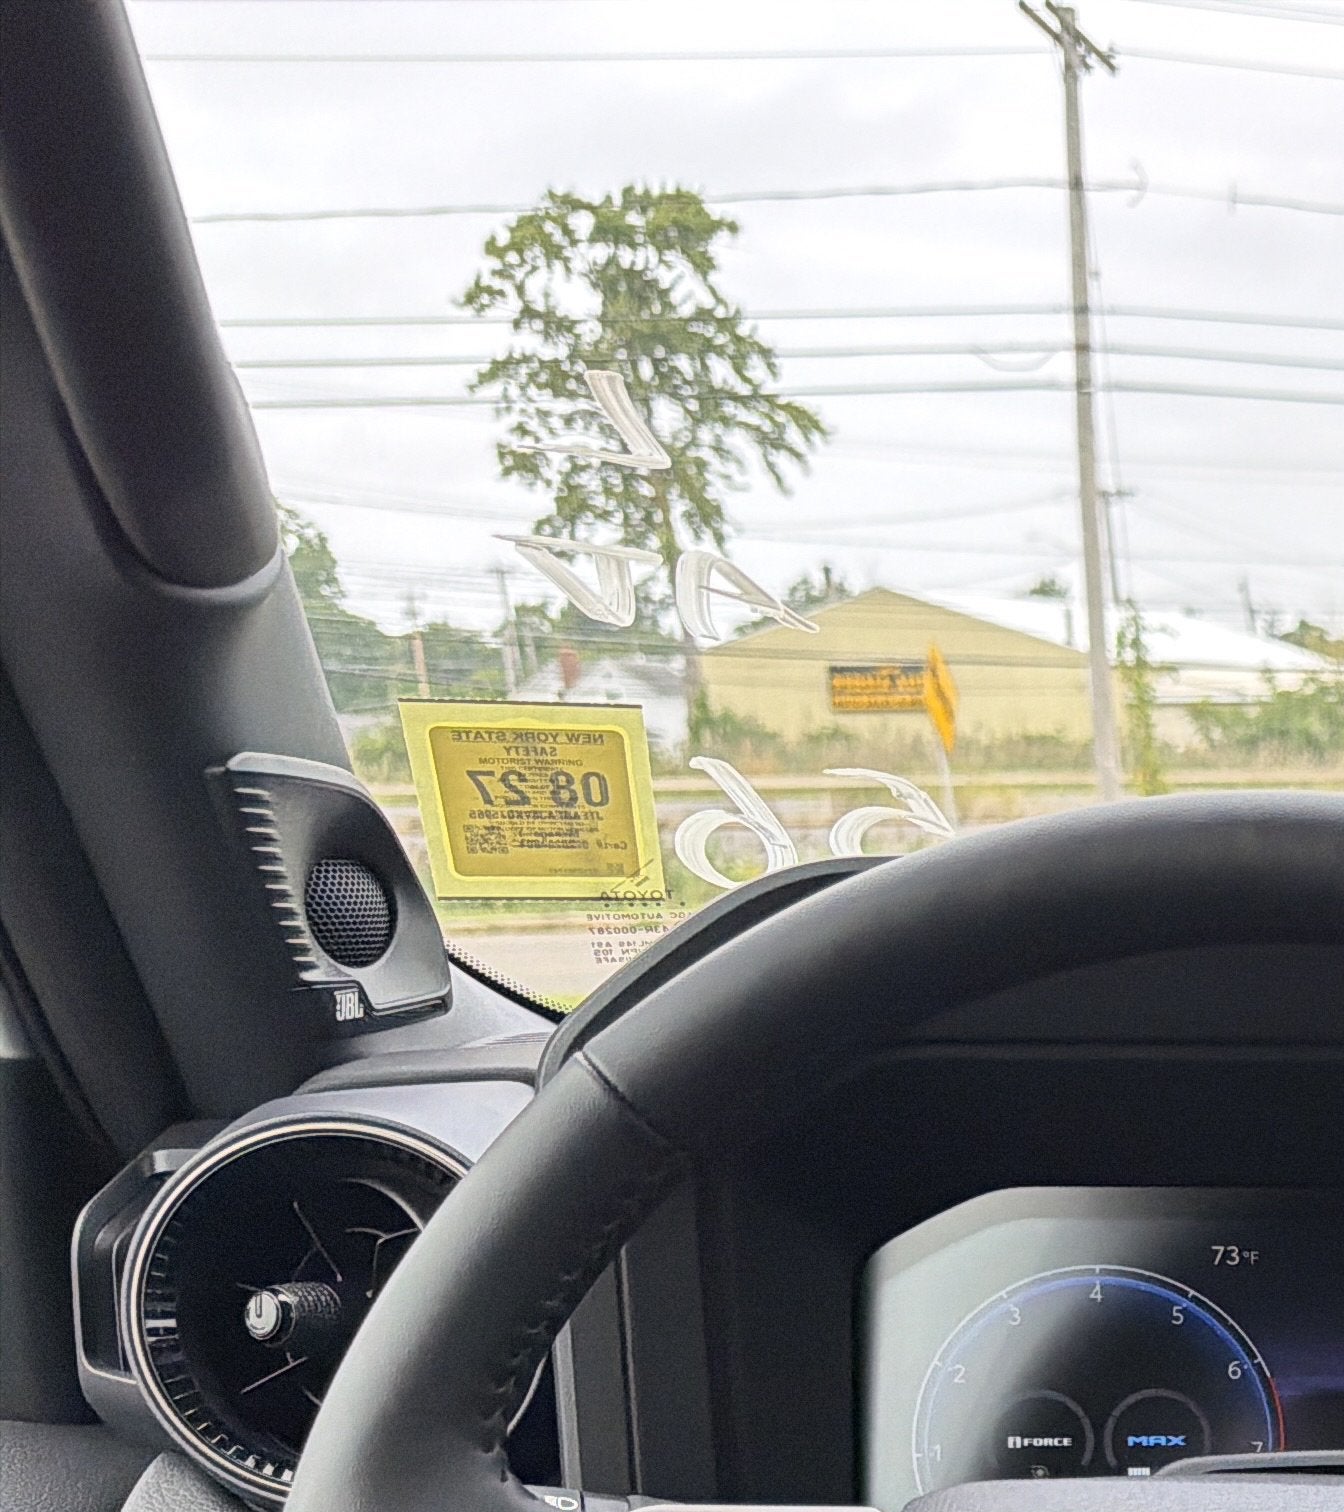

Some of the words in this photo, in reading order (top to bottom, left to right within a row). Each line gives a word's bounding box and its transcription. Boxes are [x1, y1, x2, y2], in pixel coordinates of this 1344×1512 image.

[336, 991, 364, 1021] JBL
[1089, 1285, 1102, 1302] 4
[1009, 1307, 1021, 1325] 3
[1172, 1306, 1184, 1324] 5
[954, 1366, 965, 1383] 2
[1228, 1361, 1242, 1379] 6
[1127, 1435, 1186, 1446] MAX
